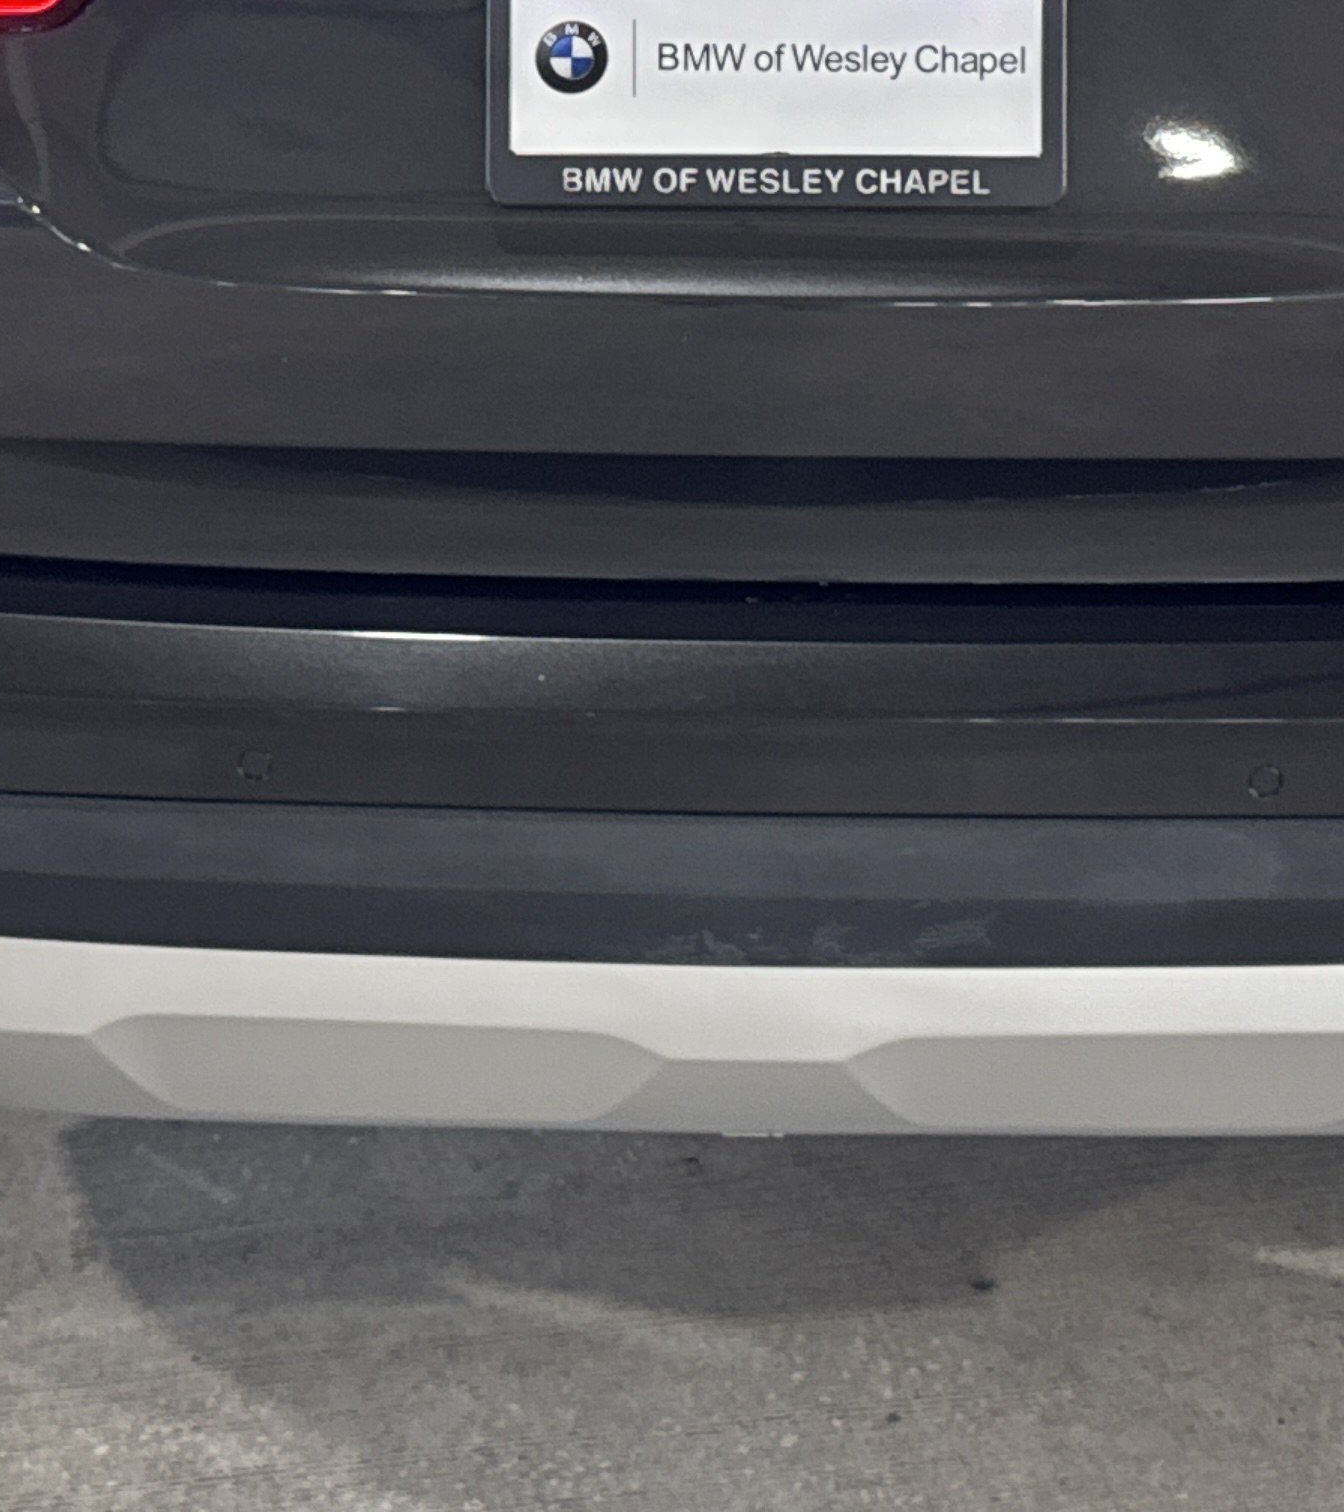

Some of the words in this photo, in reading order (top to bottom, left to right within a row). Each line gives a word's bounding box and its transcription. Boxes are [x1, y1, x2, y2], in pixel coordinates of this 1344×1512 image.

[542, 23, 602, 47] BMW
[658, 42, 746, 71] BMW
[754, 43, 786, 72] of
[791, 43, 907, 81] Wesley
[915, 44, 1026, 81] Chapel
[562, 167, 643, 193] BMW
[653, 167, 699, 194] OF
[705, 167, 844, 194] WESLEY
[855, 168, 991, 195] CHAPEL
